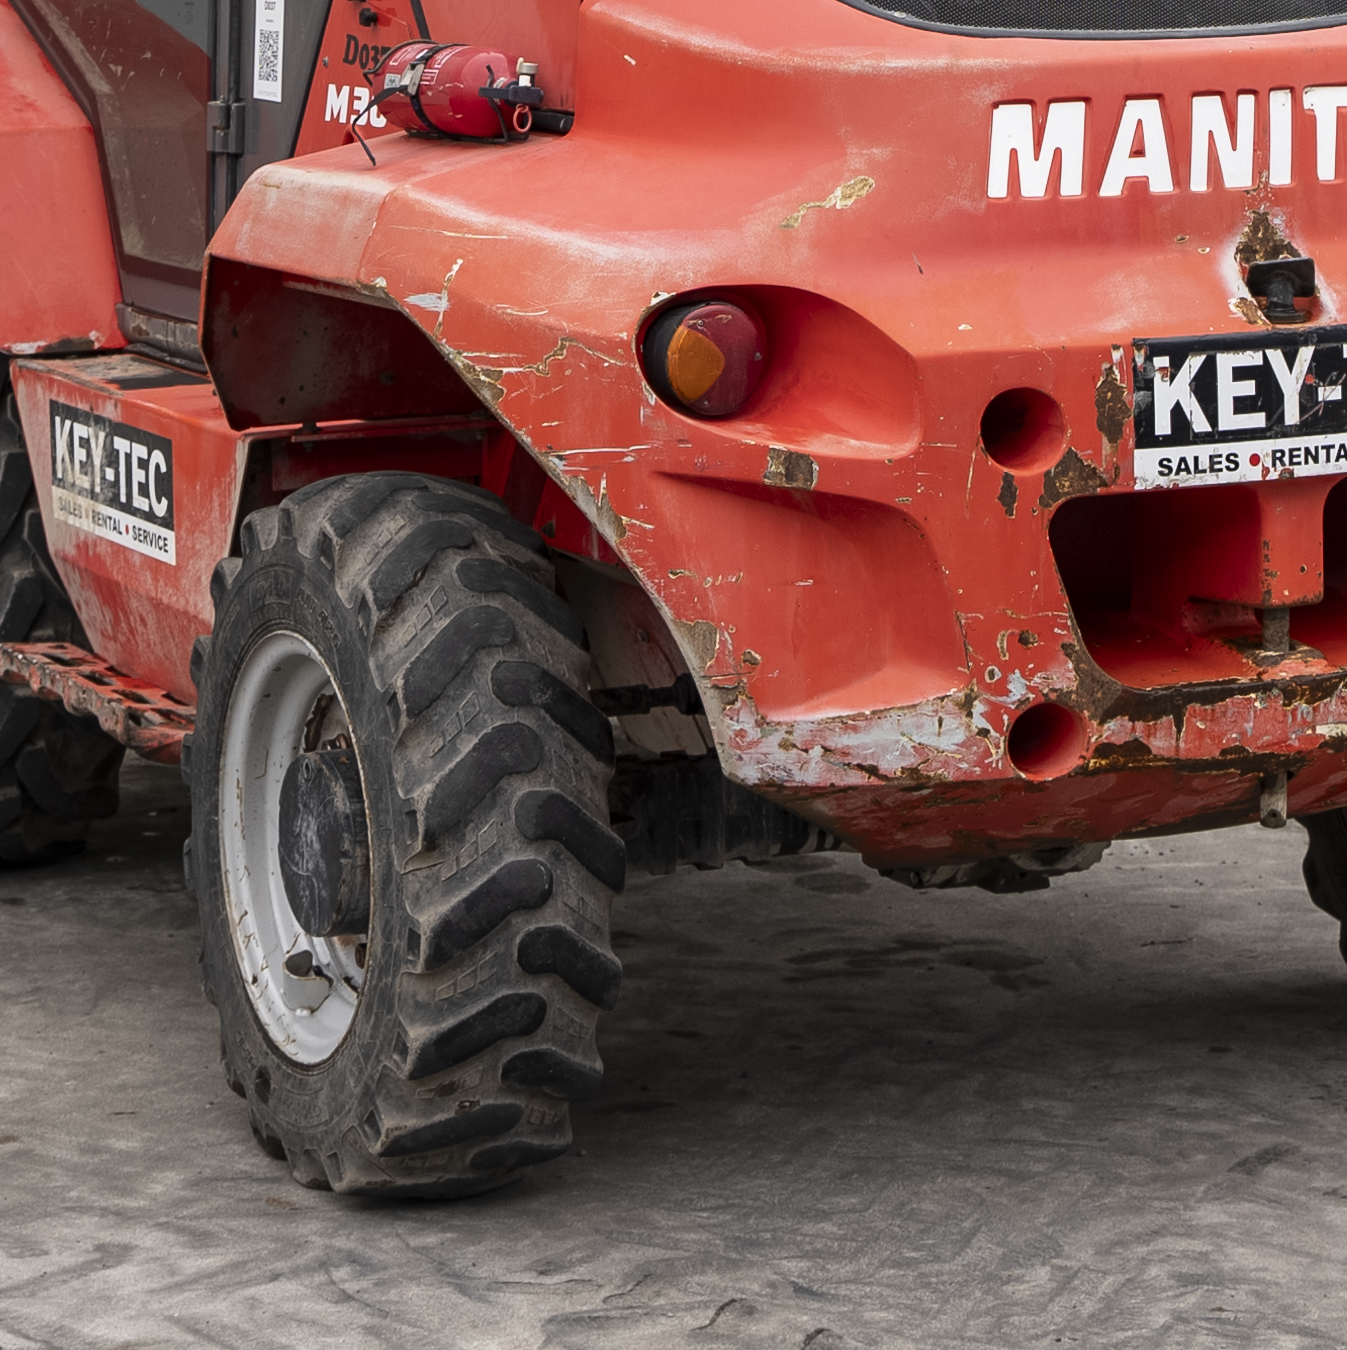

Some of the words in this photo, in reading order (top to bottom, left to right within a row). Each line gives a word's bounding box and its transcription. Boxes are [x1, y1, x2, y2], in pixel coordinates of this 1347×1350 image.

[54, 415, 169, 518] KEY-TEC
[1157, 452, 1241, 478] SALES
[57, 496, 83, 520] SALES
[91, 509, 123, 536] RENTAL
[131, 524, 170, 554] SERVICE
